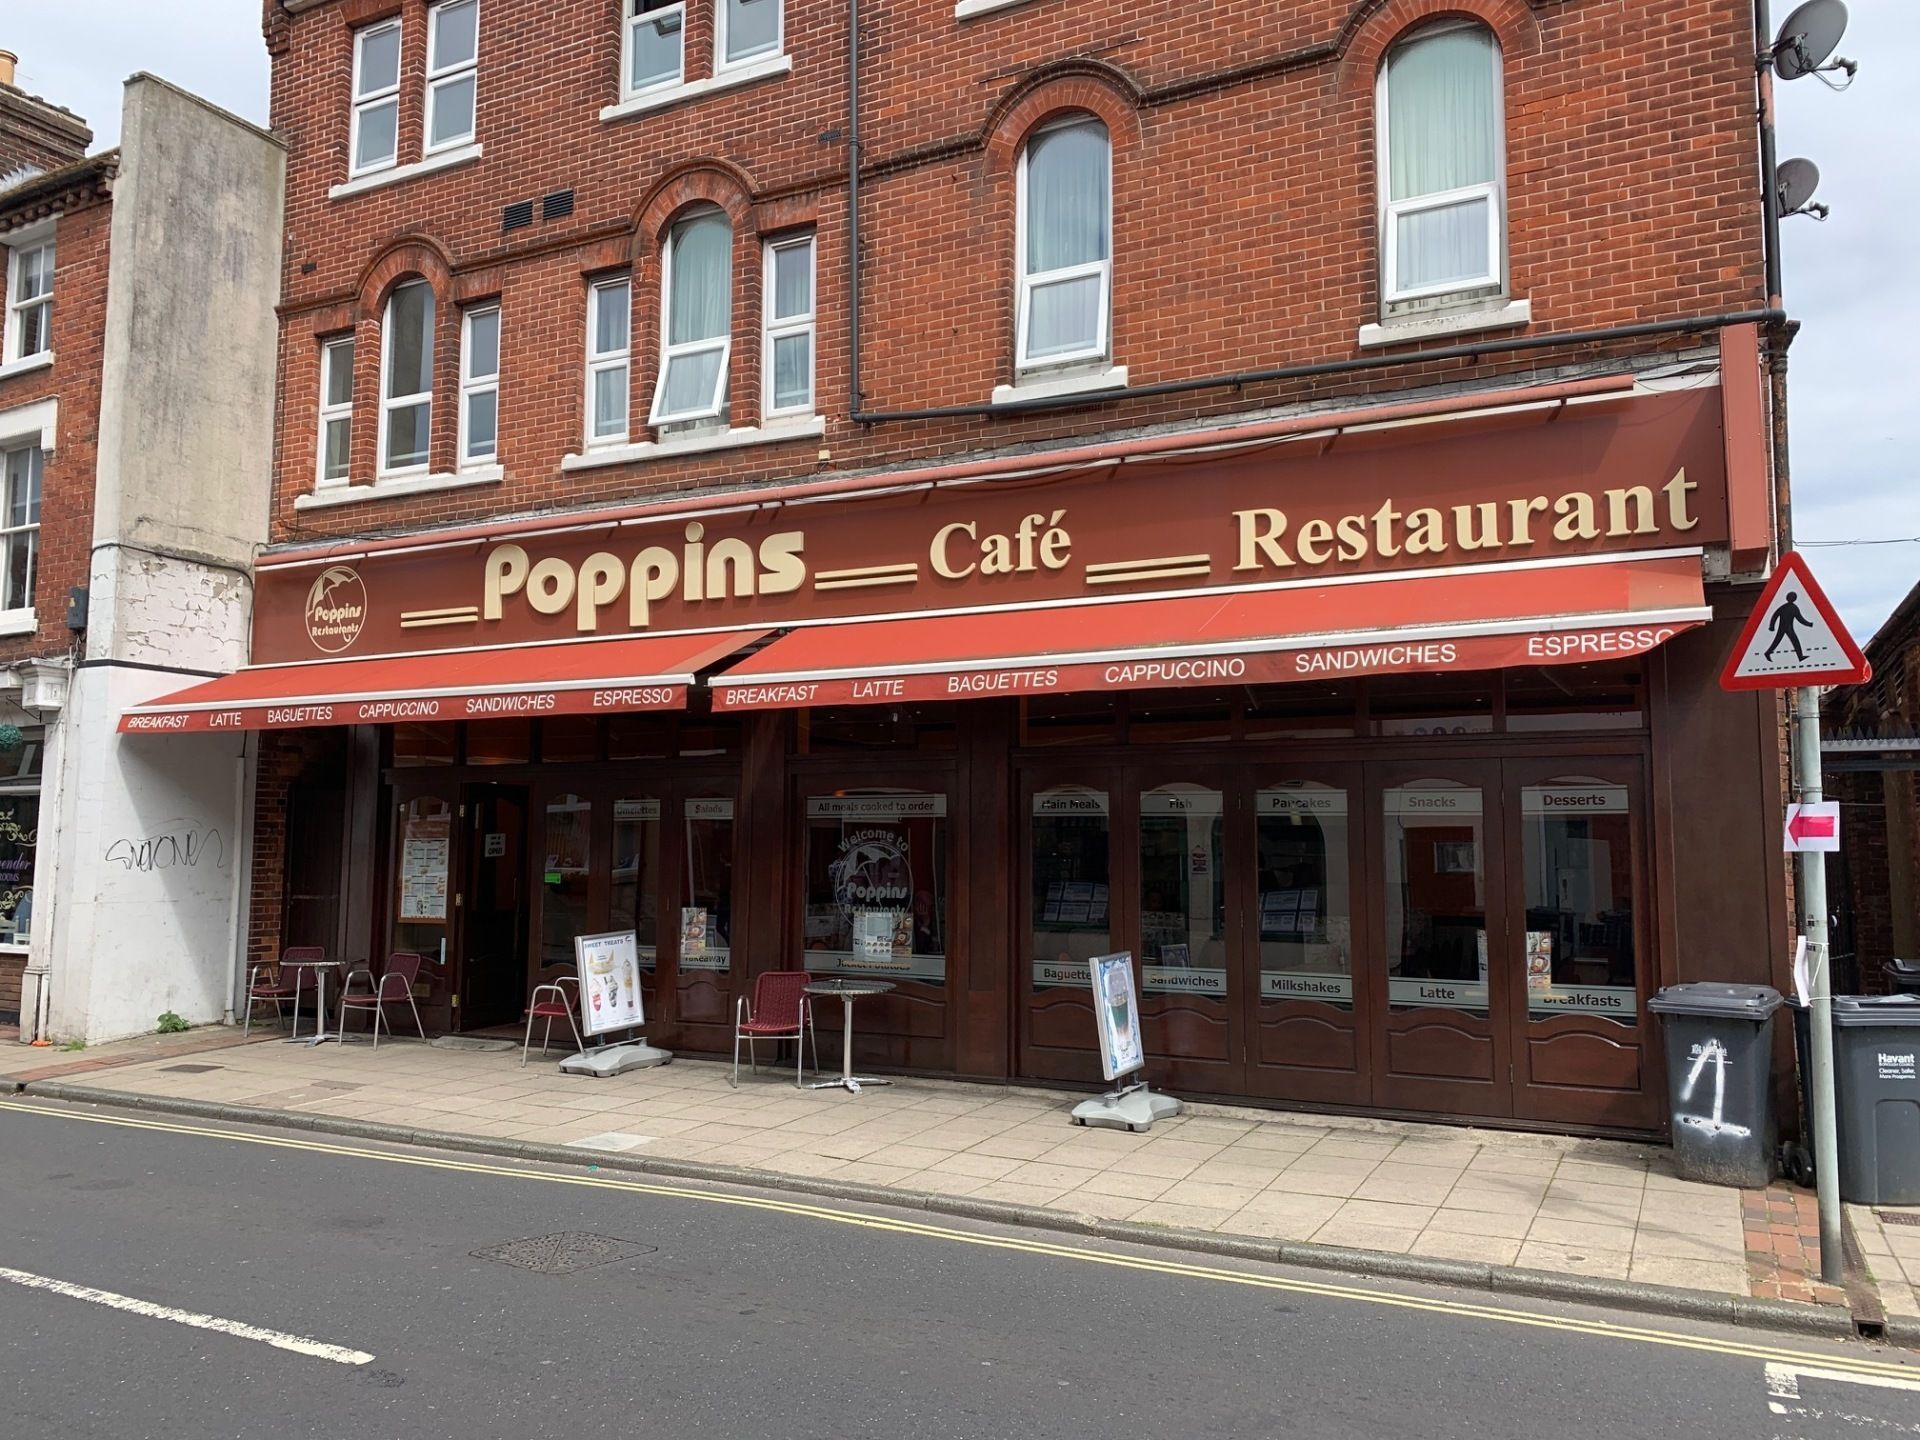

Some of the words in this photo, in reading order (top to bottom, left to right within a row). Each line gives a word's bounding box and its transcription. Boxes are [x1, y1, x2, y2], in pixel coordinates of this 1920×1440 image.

[484, 521, 807, 631] Poppins
[929, 509, 1073, 580] Café
[1232, 466, 1699, 571] Restaurant
[314, 603, 362, 623] Poppins
[311, 623, 360, 637] Restaurants
[725, 684, 819, 706] BREAKFAST
[852, 680, 905, 699] LATTE
[947, 670, 1058, 694] BAGUETTES
[1104, 658, 1246, 683] CAPPUCCINO
[1295, 643, 1457, 674] SANDWICHES
[127, 715, 189, 729] BREAKFAST
[209, 712, 242, 727] LATTE
[267, 706, 333, 724] BAGUETTES
[358, 700, 440, 719] CAPPUCCINO
[465, 694, 556, 714] SANDWICHES
[592, 688, 673, 707] ESPRESSO
[908, 801, 934, 811] order
[1070, 799, 1101, 810] Meals
[1169, 798, 1192, 809] Fish
[1408, 796, 1457, 808] Snacks
[1543, 793, 1606, 806] Desserts
[837, 829, 895, 853] Welcome
[896, 835, 908, 852] to
[847, 882, 908, 902] Poppins
[1044, 967, 1092, 982] Baguette
[1271, 978, 1342, 994] Milkshakes
[1419, 986, 1456, 1000] Latte
[1878, 1053, 1915, 1063] Havant
